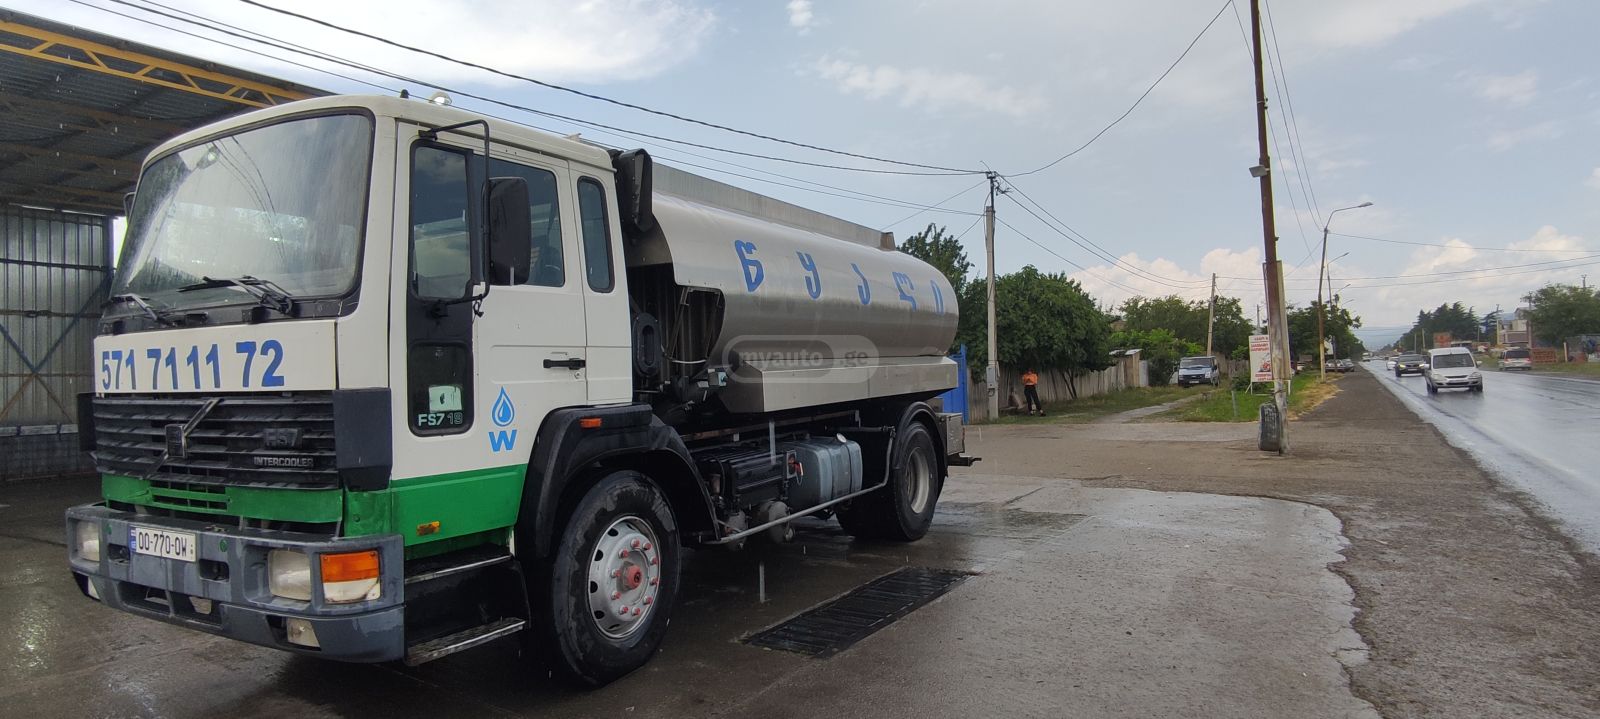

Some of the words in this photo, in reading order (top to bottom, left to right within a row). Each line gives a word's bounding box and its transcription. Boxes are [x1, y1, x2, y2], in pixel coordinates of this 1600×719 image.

[102, 349, 137, 390] 571
[146, 343, 221, 390] 7111
[235, 339, 285, 388] 72
[418, 413, 445, 426] FS7
[488, 429, 518, 452] W
[253, 456, 314, 468] INTERCOOLER
